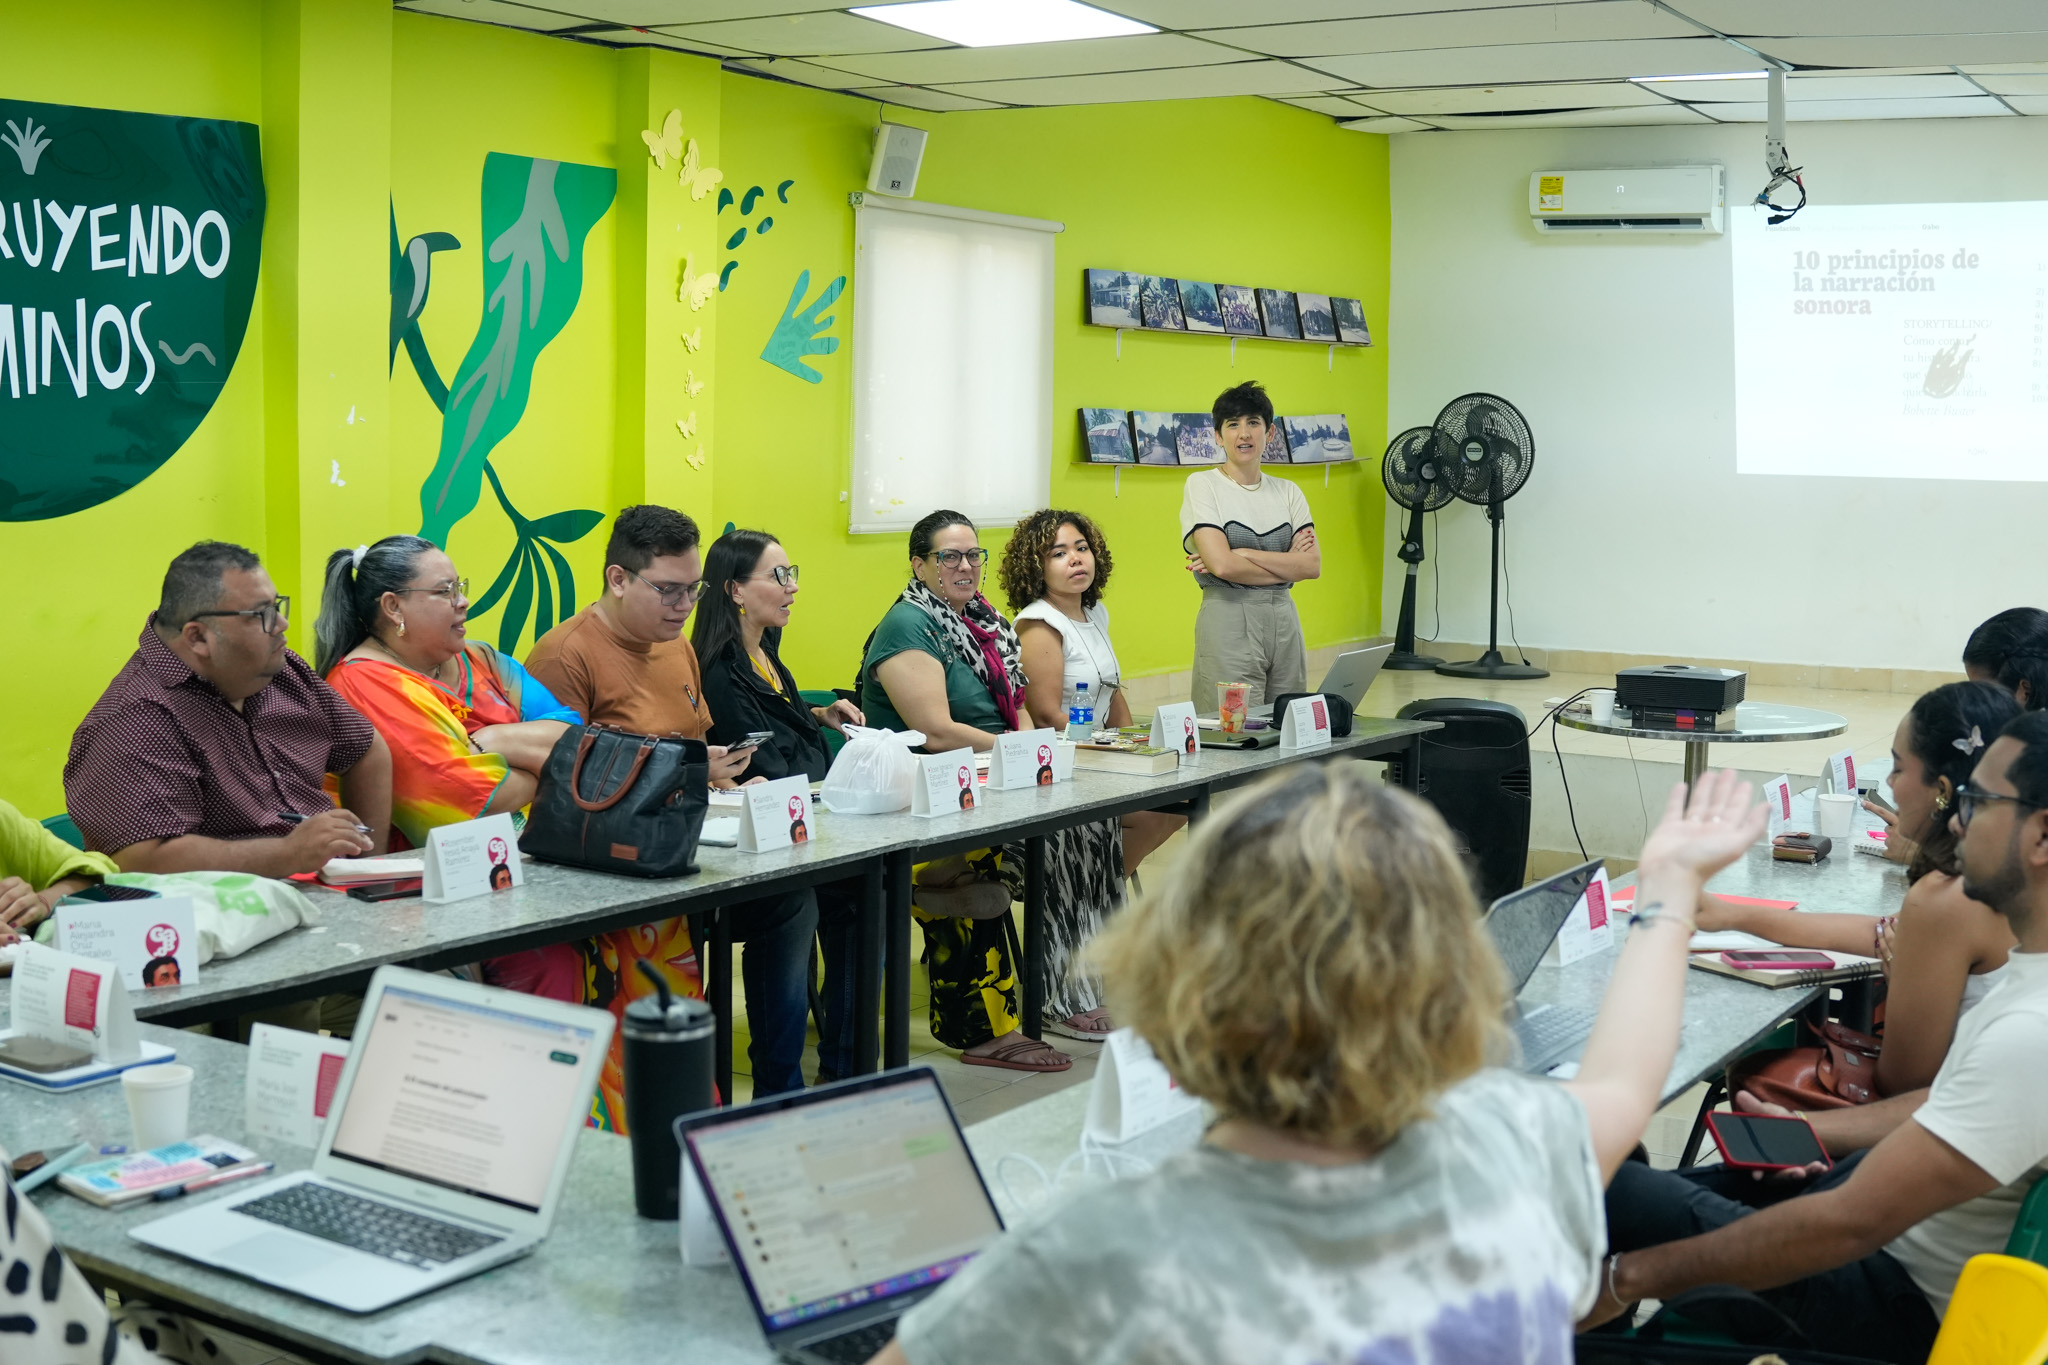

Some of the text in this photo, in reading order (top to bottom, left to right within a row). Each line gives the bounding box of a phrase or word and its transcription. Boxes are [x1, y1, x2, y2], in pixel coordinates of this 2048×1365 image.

[1793, 247, 1980, 276] 10 principios de
[1793, 270, 1936, 293] la narración
[1793, 299, 1873, 315] sonora
